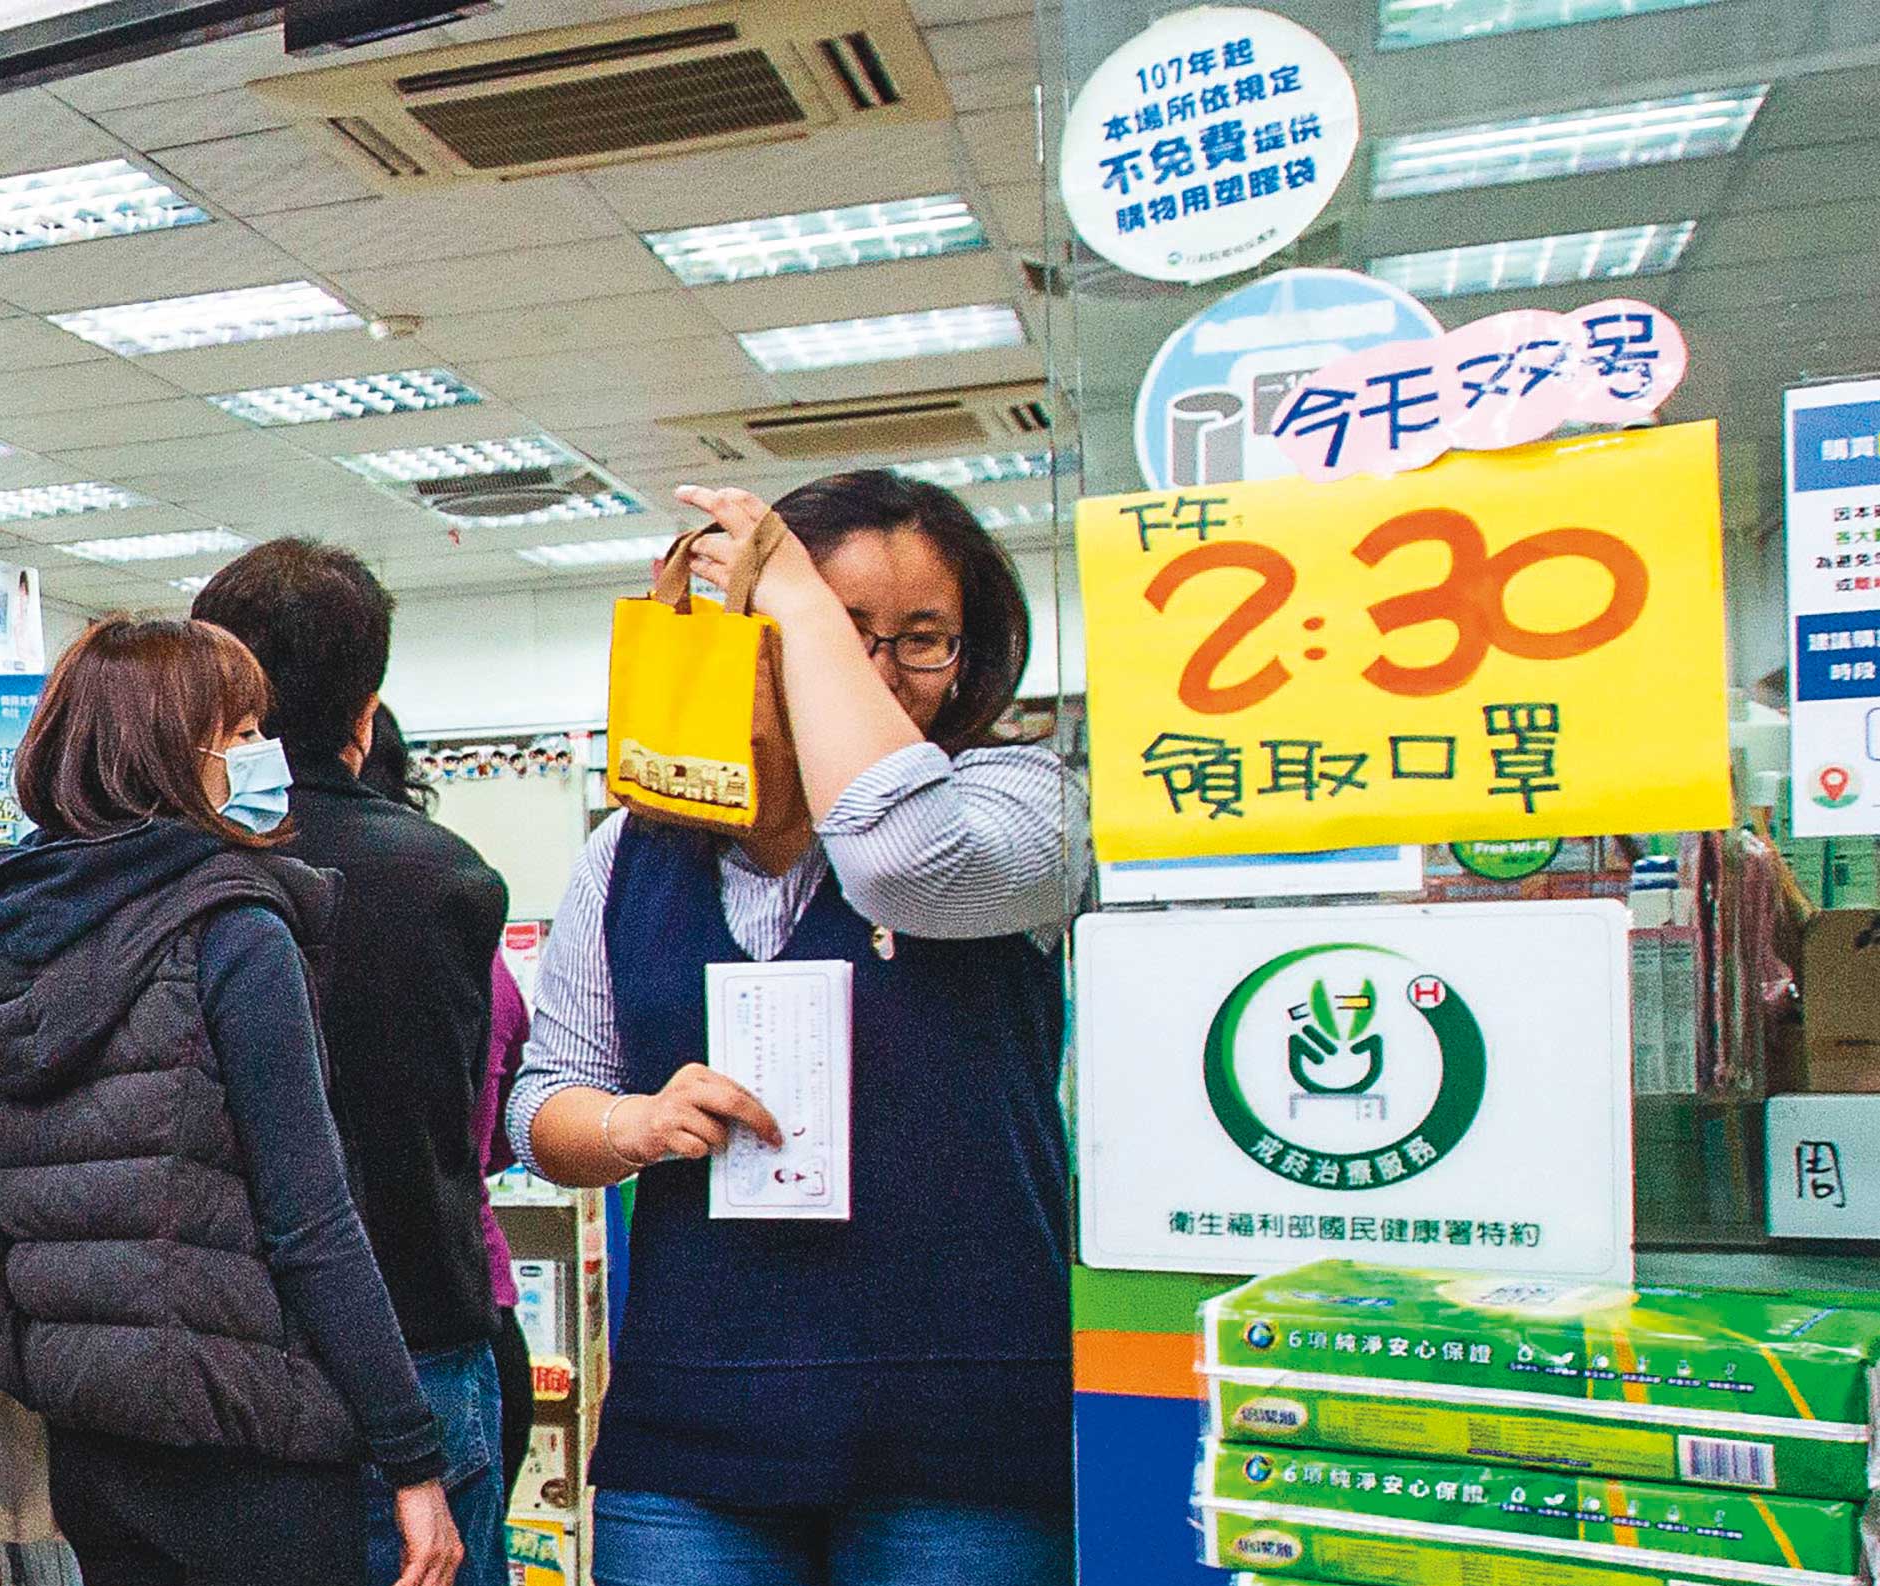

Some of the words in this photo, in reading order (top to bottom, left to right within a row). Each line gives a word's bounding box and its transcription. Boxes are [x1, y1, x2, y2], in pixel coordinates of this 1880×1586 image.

[1136, 37, 1255, 94] 107年起
[1103, 65, 1302, 141] 本場所依規定
[1099, 113, 1322, 194] 不免費提供
[1116, 156, 1316, 234] 購物用塑膠袋
[1144, 507, 1650, 716] 2:30
[1142, 702, 1562, 818] 領取口罩
[1251, 1131, 1439, 1189] 戒菸治療服務
[1168, 1210, 1543, 1249] 衛生福利部國民健康署特約
[1288, 1329, 1493, 1366] 6項純淨安心保證
[1282, 1464, 1489, 1507] 6項純淨安心保證
